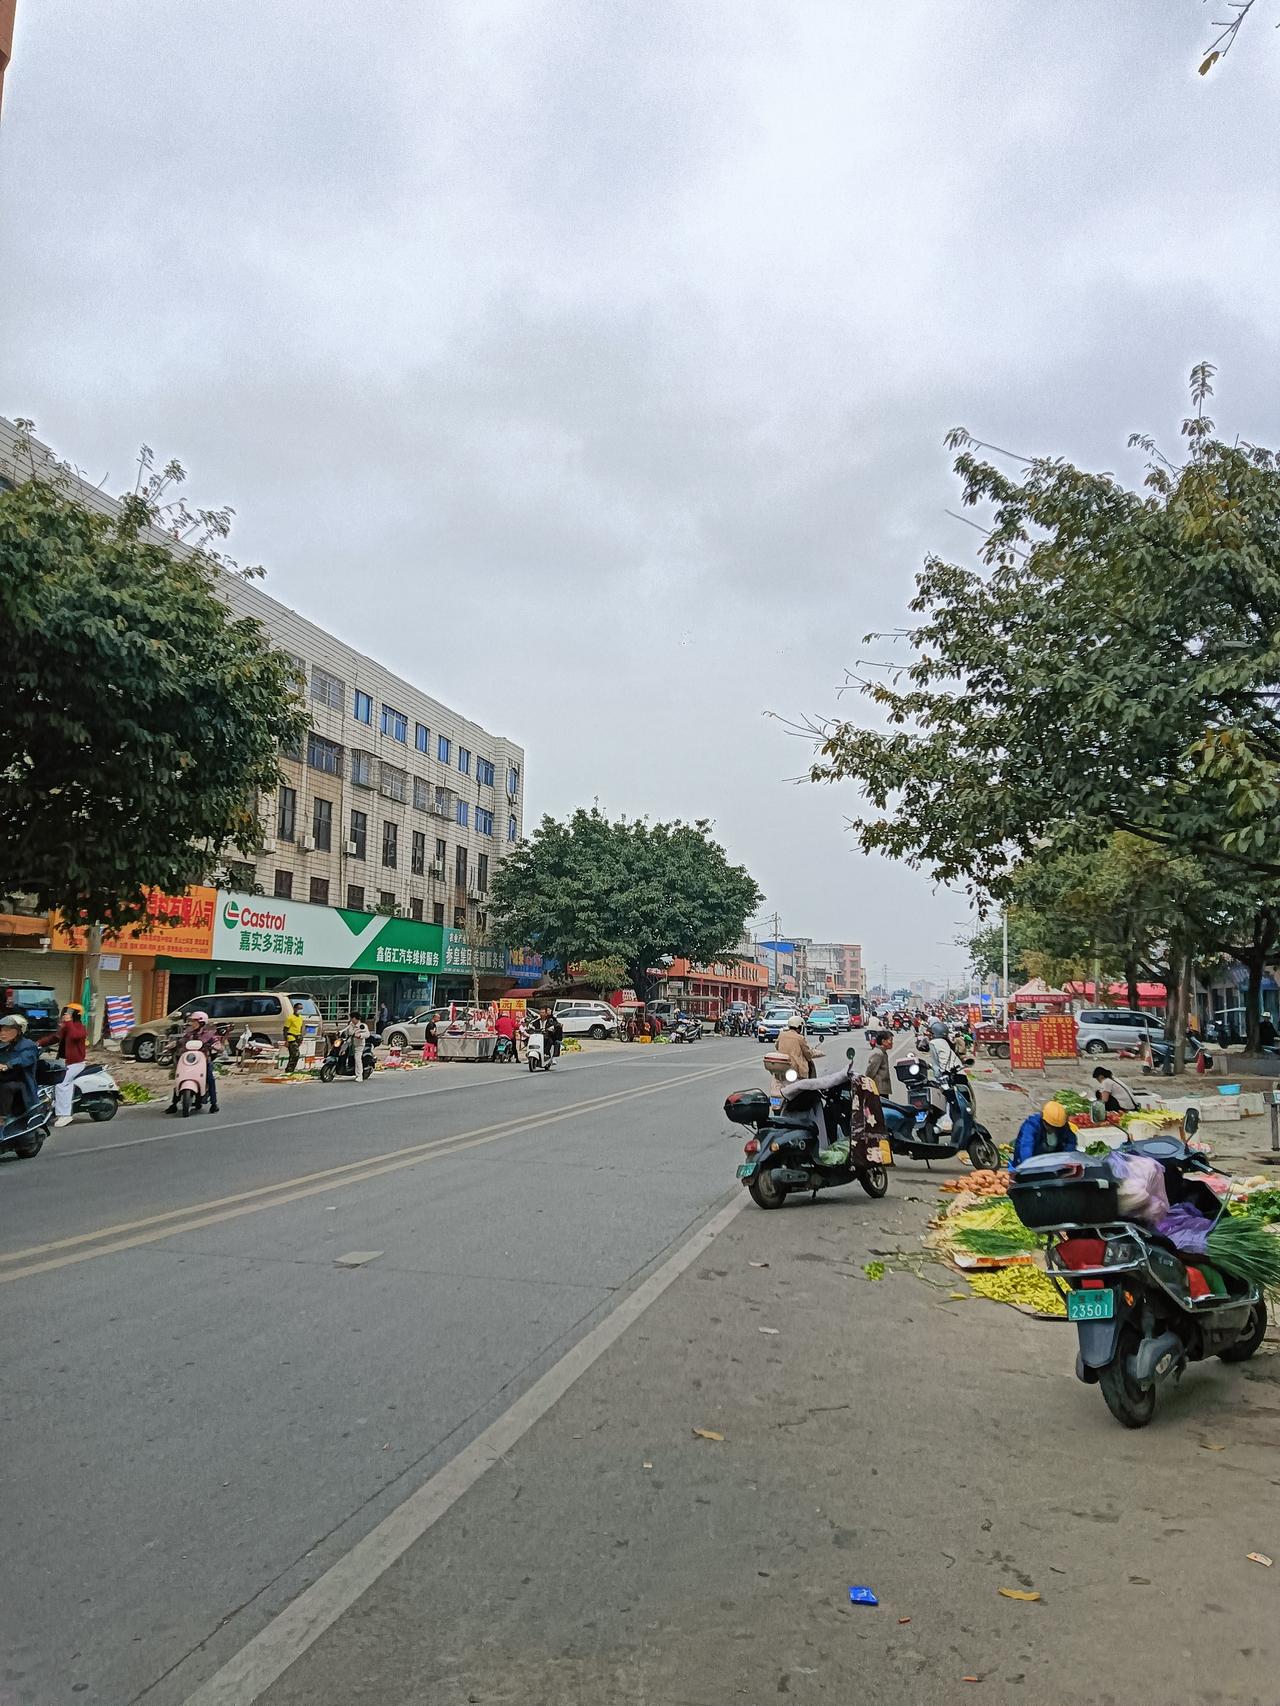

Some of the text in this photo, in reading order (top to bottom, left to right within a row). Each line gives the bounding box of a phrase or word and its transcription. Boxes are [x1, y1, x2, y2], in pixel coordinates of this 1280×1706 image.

[240, 907, 287, 931] Castrol
[239, 930, 305, 956] 嘉实多润滑油
[376, 945, 440, 966] 鑫佰汇汽车维修服务
[1072, 1304, 1108, 1318] 23501
